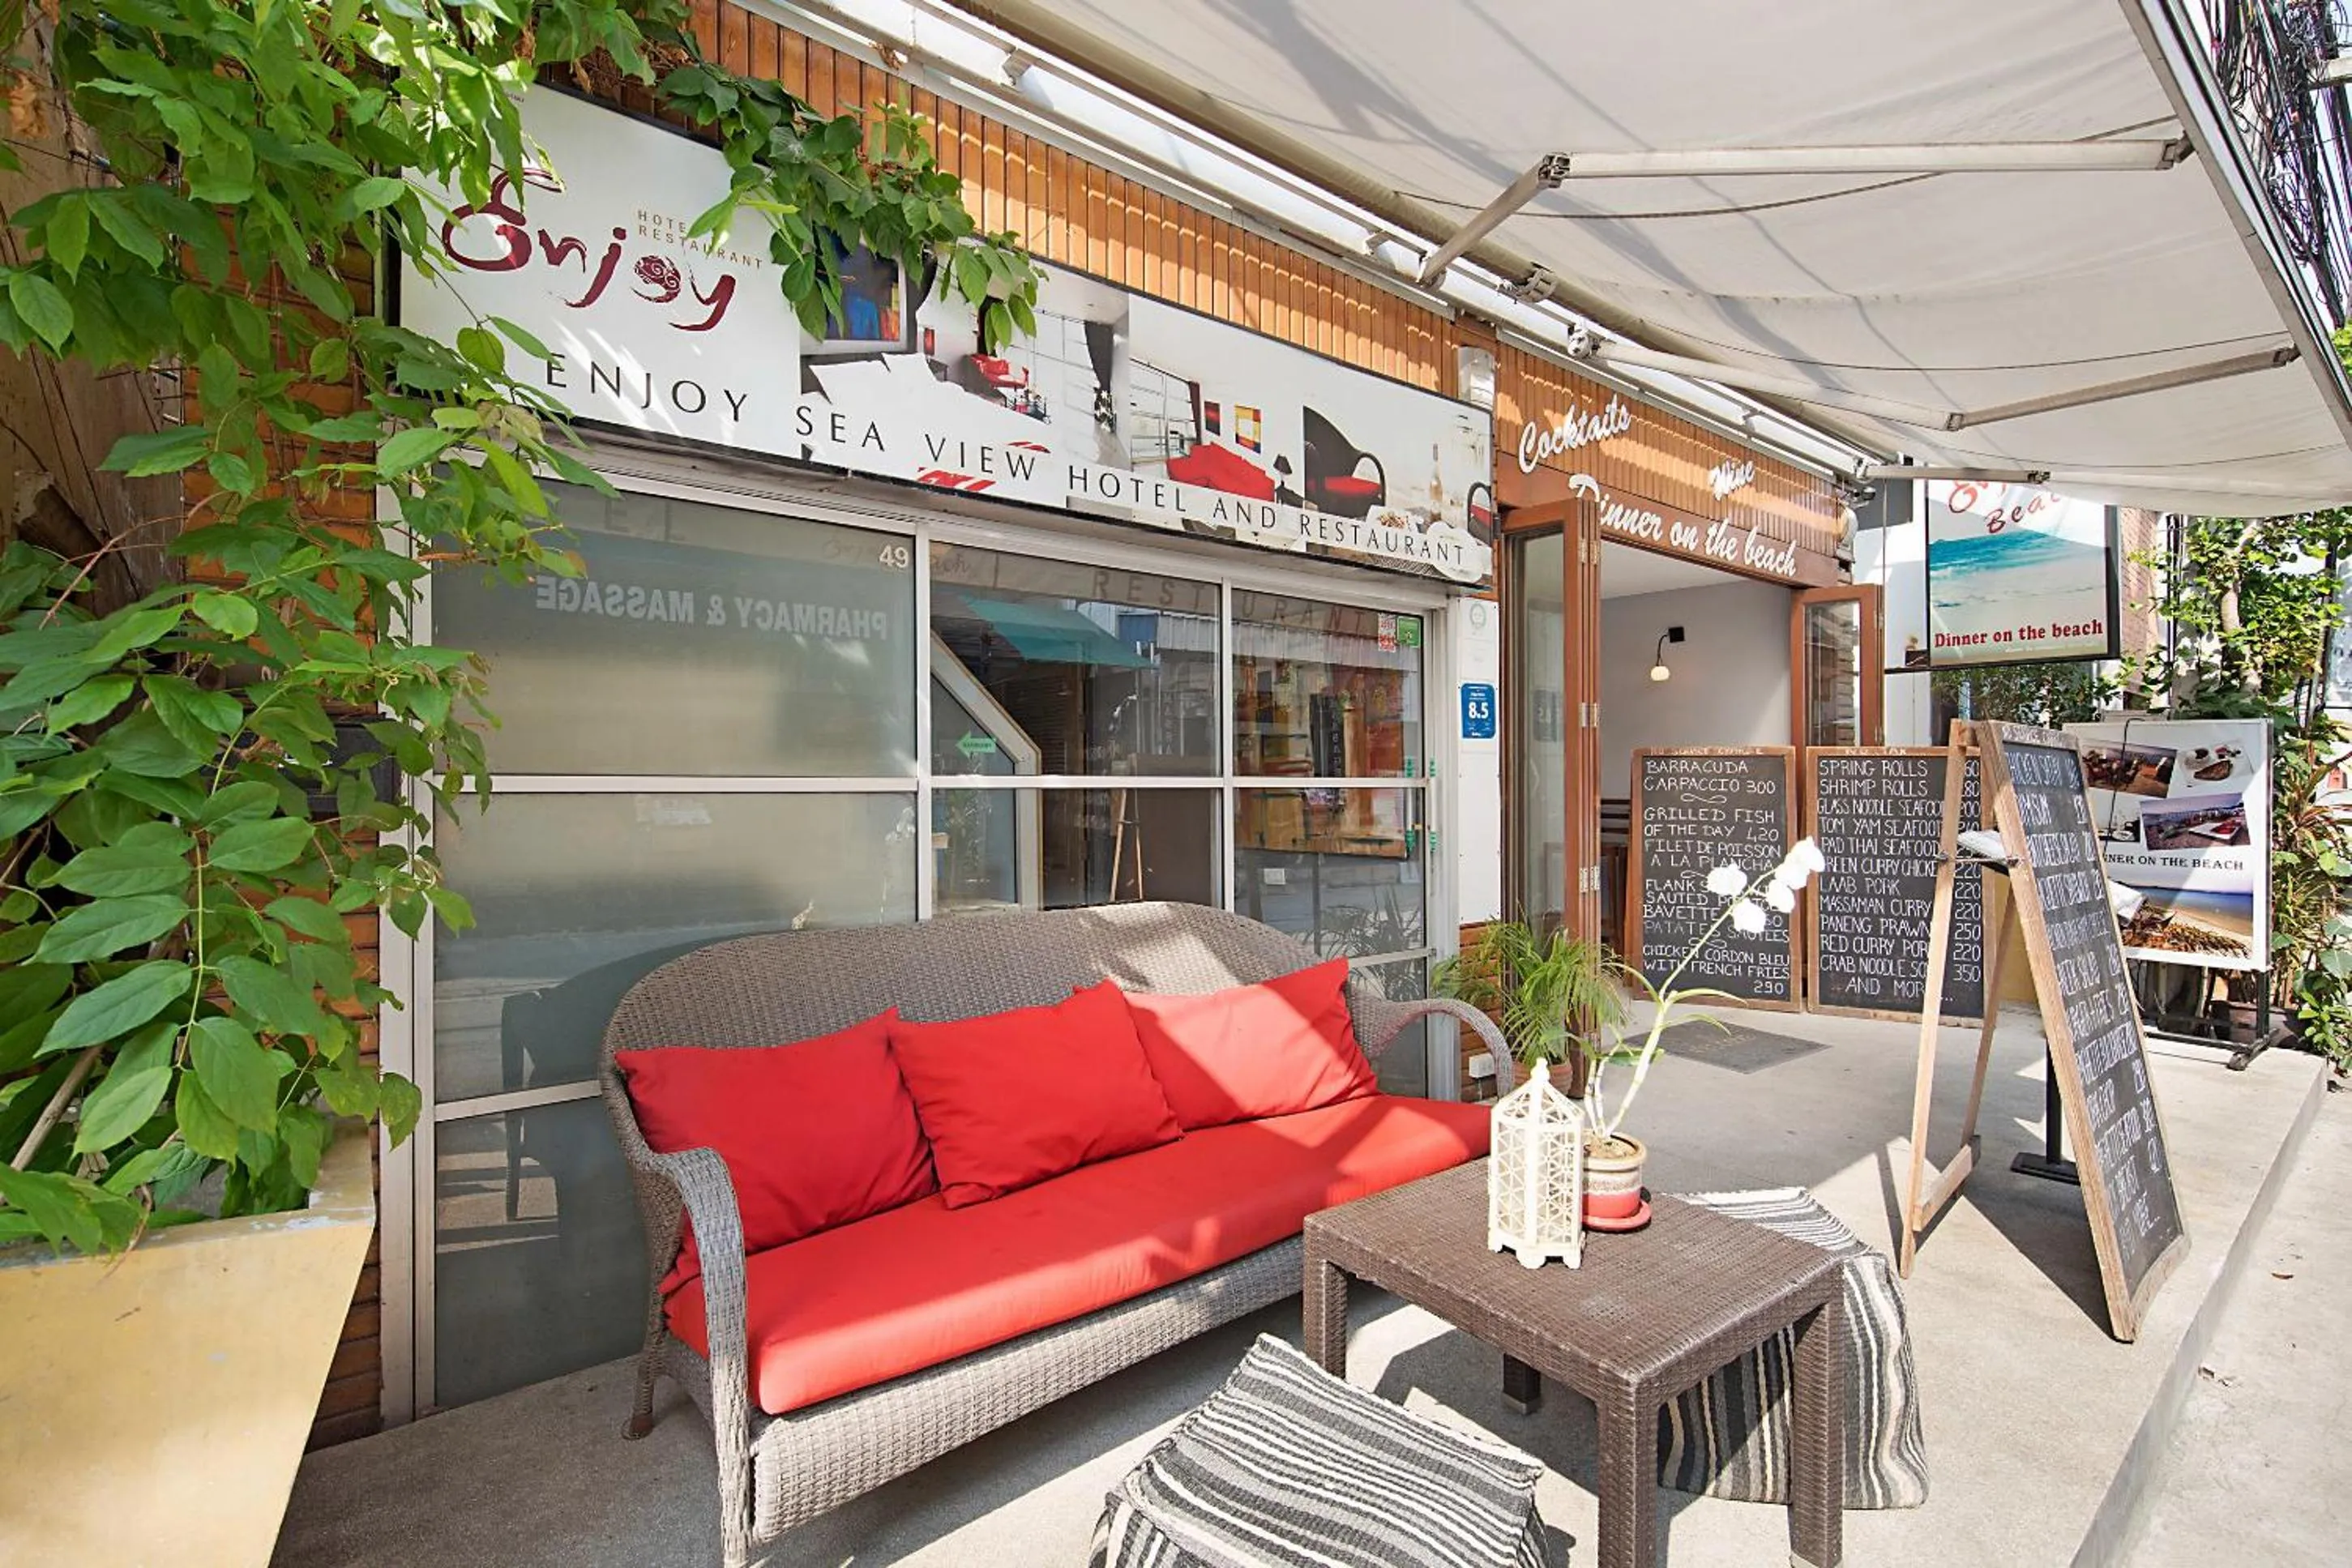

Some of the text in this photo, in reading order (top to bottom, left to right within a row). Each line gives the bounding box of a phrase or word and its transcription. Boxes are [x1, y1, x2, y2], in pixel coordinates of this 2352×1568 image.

[638, 210, 688, 234] HOTE
[442, 165, 736, 331] Enjoy
[1519, 394, 1631, 473] Cocktails
[546, 352, 1465, 566] ENJOY SEA VIEW HOTEL AND RESTAURANT
[1708, 459, 1755, 501] Wine
[879, 544, 909, 568] 49
[1670, 521, 1699, 551] on
[1704, 518, 1738, 559] the
[1744, 528, 1798, 577] beach
[1935, 619, 2103, 647] Dinner on the beach
[1469, 702, 1489, 720] 8.5
[1645, 760, 1749, 774] BARRACUDA
[1819, 760, 1875, 776] SPRING
[1882, 760, 1928, 776] ROLLS
[1644, 776, 1776, 794] CARPACCIO 300
[1820, 779, 1875, 796] SHRIMP
[1882, 780, 1928, 797] ROLLS
[1644, 807, 1775, 824] GRILLED FISH
[1817, 798, 1944, 816] GLASS NOODLE SEAFOO
[1644, 824, 1779, 842] OF THE DAY 420
[1820, 817, 1845, 835] TOM
[1854, 818, 1880, 835] YAM
[1644, 839, 1781, 858] FILET DE POISSON
[1821, 836, 1844, 853] PAD
[1846, 838, 1878, 855] THAI
[1884, 840, 1939, 857] SEAFOOD
[1651, 855, 1774, 871] A LA PLANCHA
[1824, 857, 1857, 874] REEN
[1861, 858, 1900, 875] CURRY
[1901, 860, 1937, 877] CHICKE
[2138, 855, 2156, 865] ON
[2161, 857, 2187, 867] THE
[2192, 859, 2243, 870] BEACH
[1646, 879, 1696, 892] FLANK
[1820, 876, 1981, 899] LAAB PORK 220
[1646, 891, 1708, 905] SAUTED
[1820, 895, 1981, 920] MASSAMAN CURRY 220
[1644, 904, 1721, 921] BAVETTE
[1820, 914, 1871, 934] PANENG
[1955, 923, 1981, 940] 250
[1643, 945, 1790, 965] CHICKEN CORDON BLEU
[1820, 934, 1981, 961] RED CURRY POR 220
[1691, 960, 1742, 976] FRENCH
[1748, 965, 1790, 978] FRIES
[1820, 955, 1856, 972] CRAB
[1859, 958, 1905, 977] NOODLE
[1952, 964, 1981, 982] 350
[1754, 981, 1783, 993] 290
[1845, 977, 1926, 998] AND MOR
